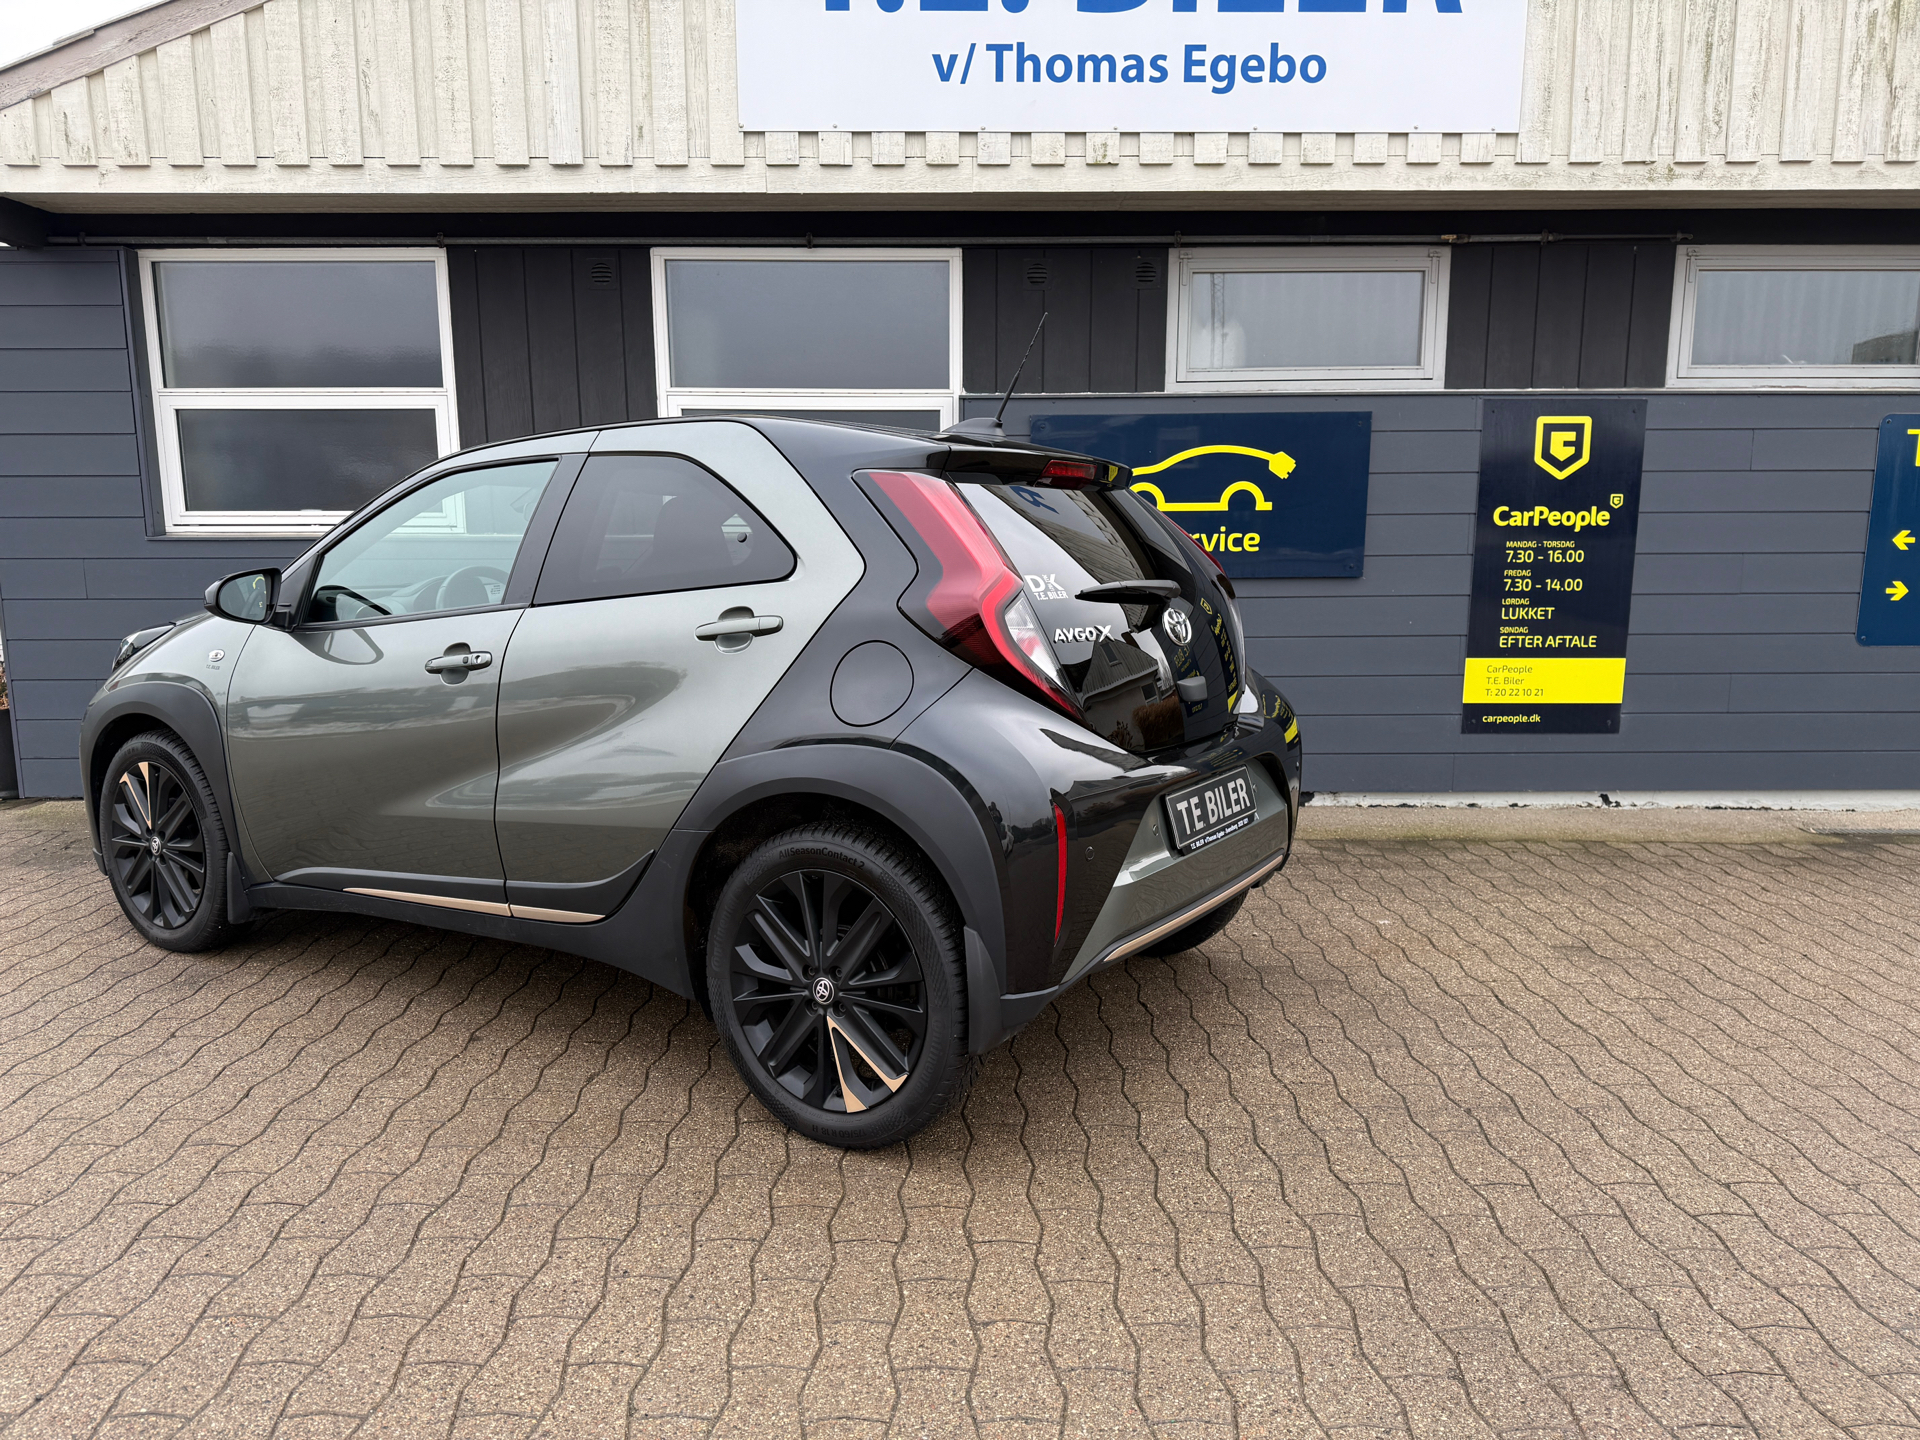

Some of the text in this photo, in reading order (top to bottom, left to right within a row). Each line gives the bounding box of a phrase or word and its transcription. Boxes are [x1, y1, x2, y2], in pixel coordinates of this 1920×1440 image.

[931, 41, 1327, 95] v/ Thomas Egebo
[1493, 506, 1611, 532] CarPeople
[1505, 550, 1534, 563] 7.30
[1547, 550, 1585, 563] 16.00
[1504, 569, 1532, 577] FREDAG
[1024, 574, 1065, 593] DK
[1503, 578, 1532, 592] 7.30
[1545, 578, 1583, 592] 14.00
[1501, 607, 1555, 620] LUKKET
[1499, 626, 1529, 634] SØNDAG
[1499, 635, 1598, 648] EFTER AFTALE
[1486, 664, 1533, 675] CarPeople
[1486, 676, 1525, 685] T.E. Biler
[1485, 688, 1544, 697] T: 20 22 10 21
[1482, 713, 1541, 725] carpeople.dk
[1204, 778, 1251, 825] BILER
[778, 846, 865, 870] AllSeasonContact 2
